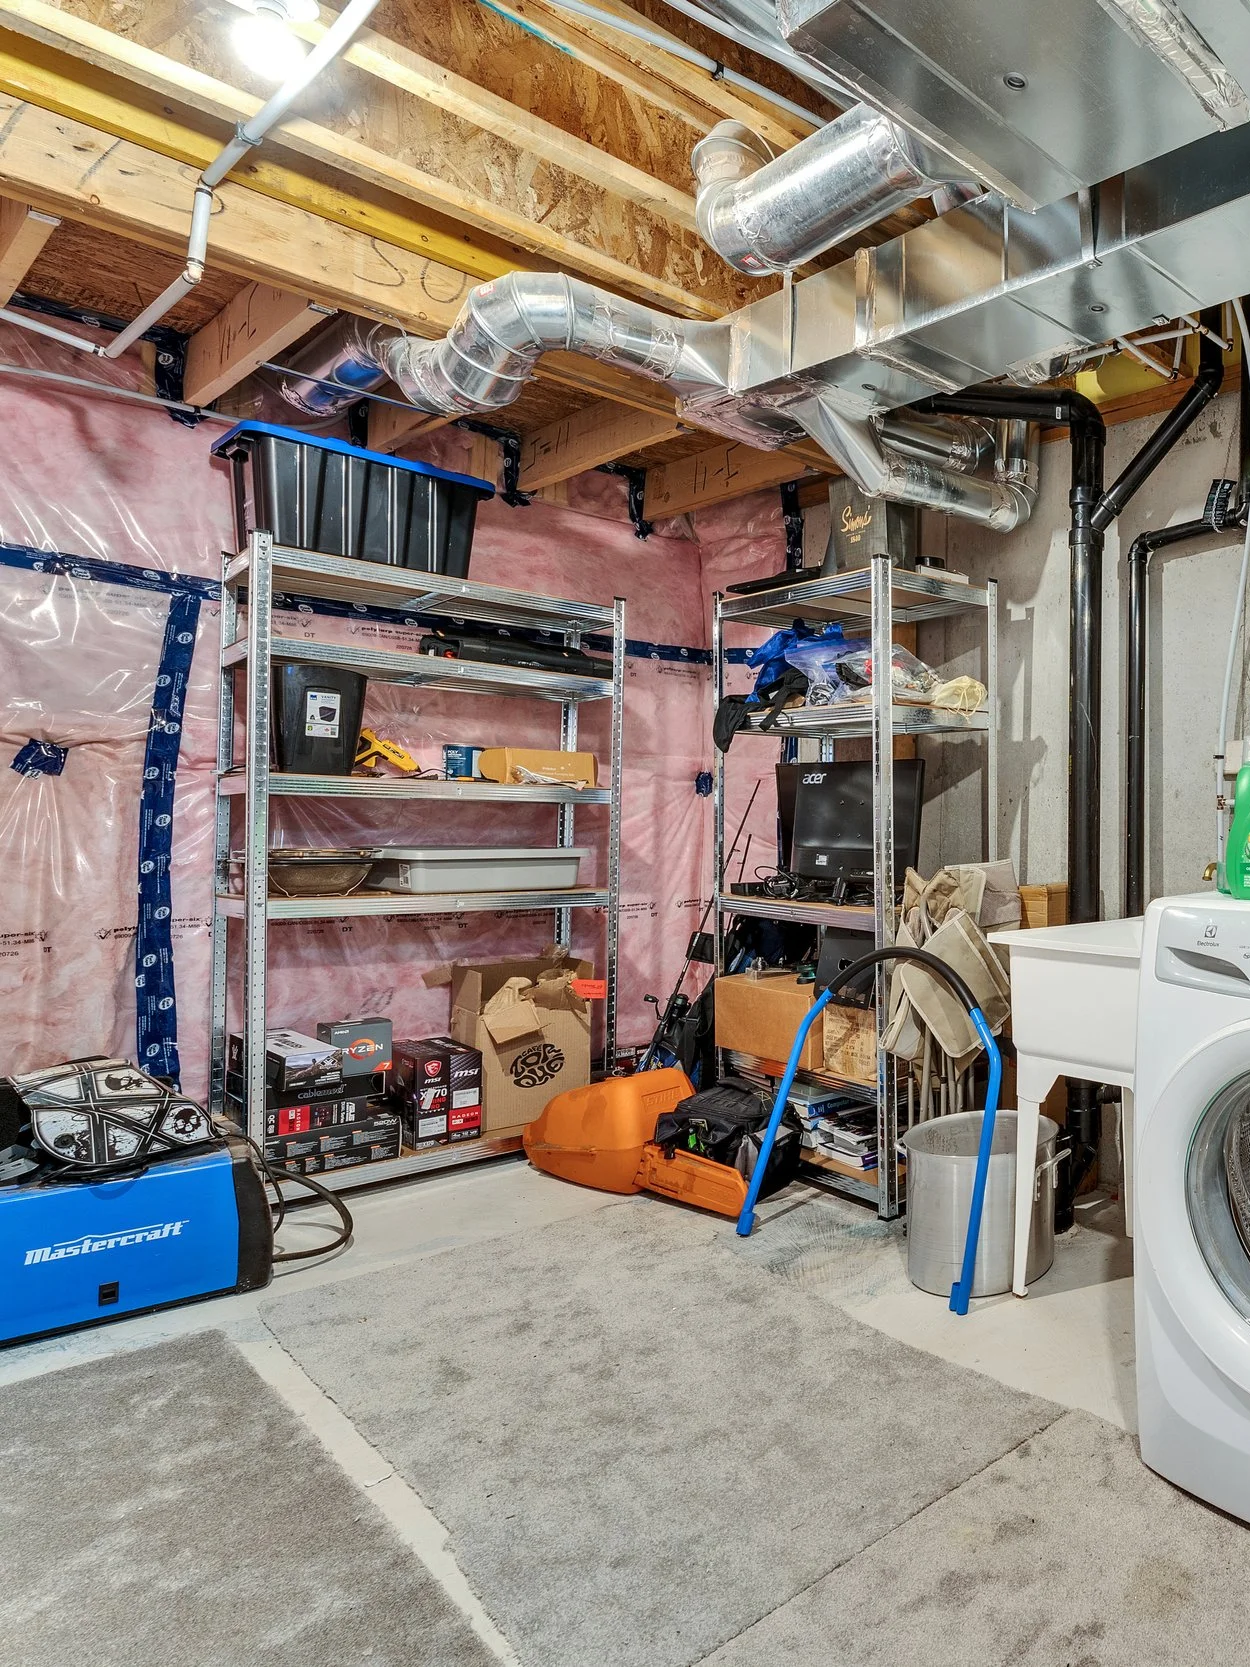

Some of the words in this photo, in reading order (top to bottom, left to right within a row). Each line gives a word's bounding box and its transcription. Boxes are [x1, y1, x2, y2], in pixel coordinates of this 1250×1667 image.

[802, 773, 827, 784] acer
[341, 1043, 384, 1054] RYZEN
[454, 1068, 480, 1078] msi
[298, 1084, 345, 1100] cablemod
[420, 1088, 447, 1100] X70
[24, 1221, 184, 1266] Mastercraft
